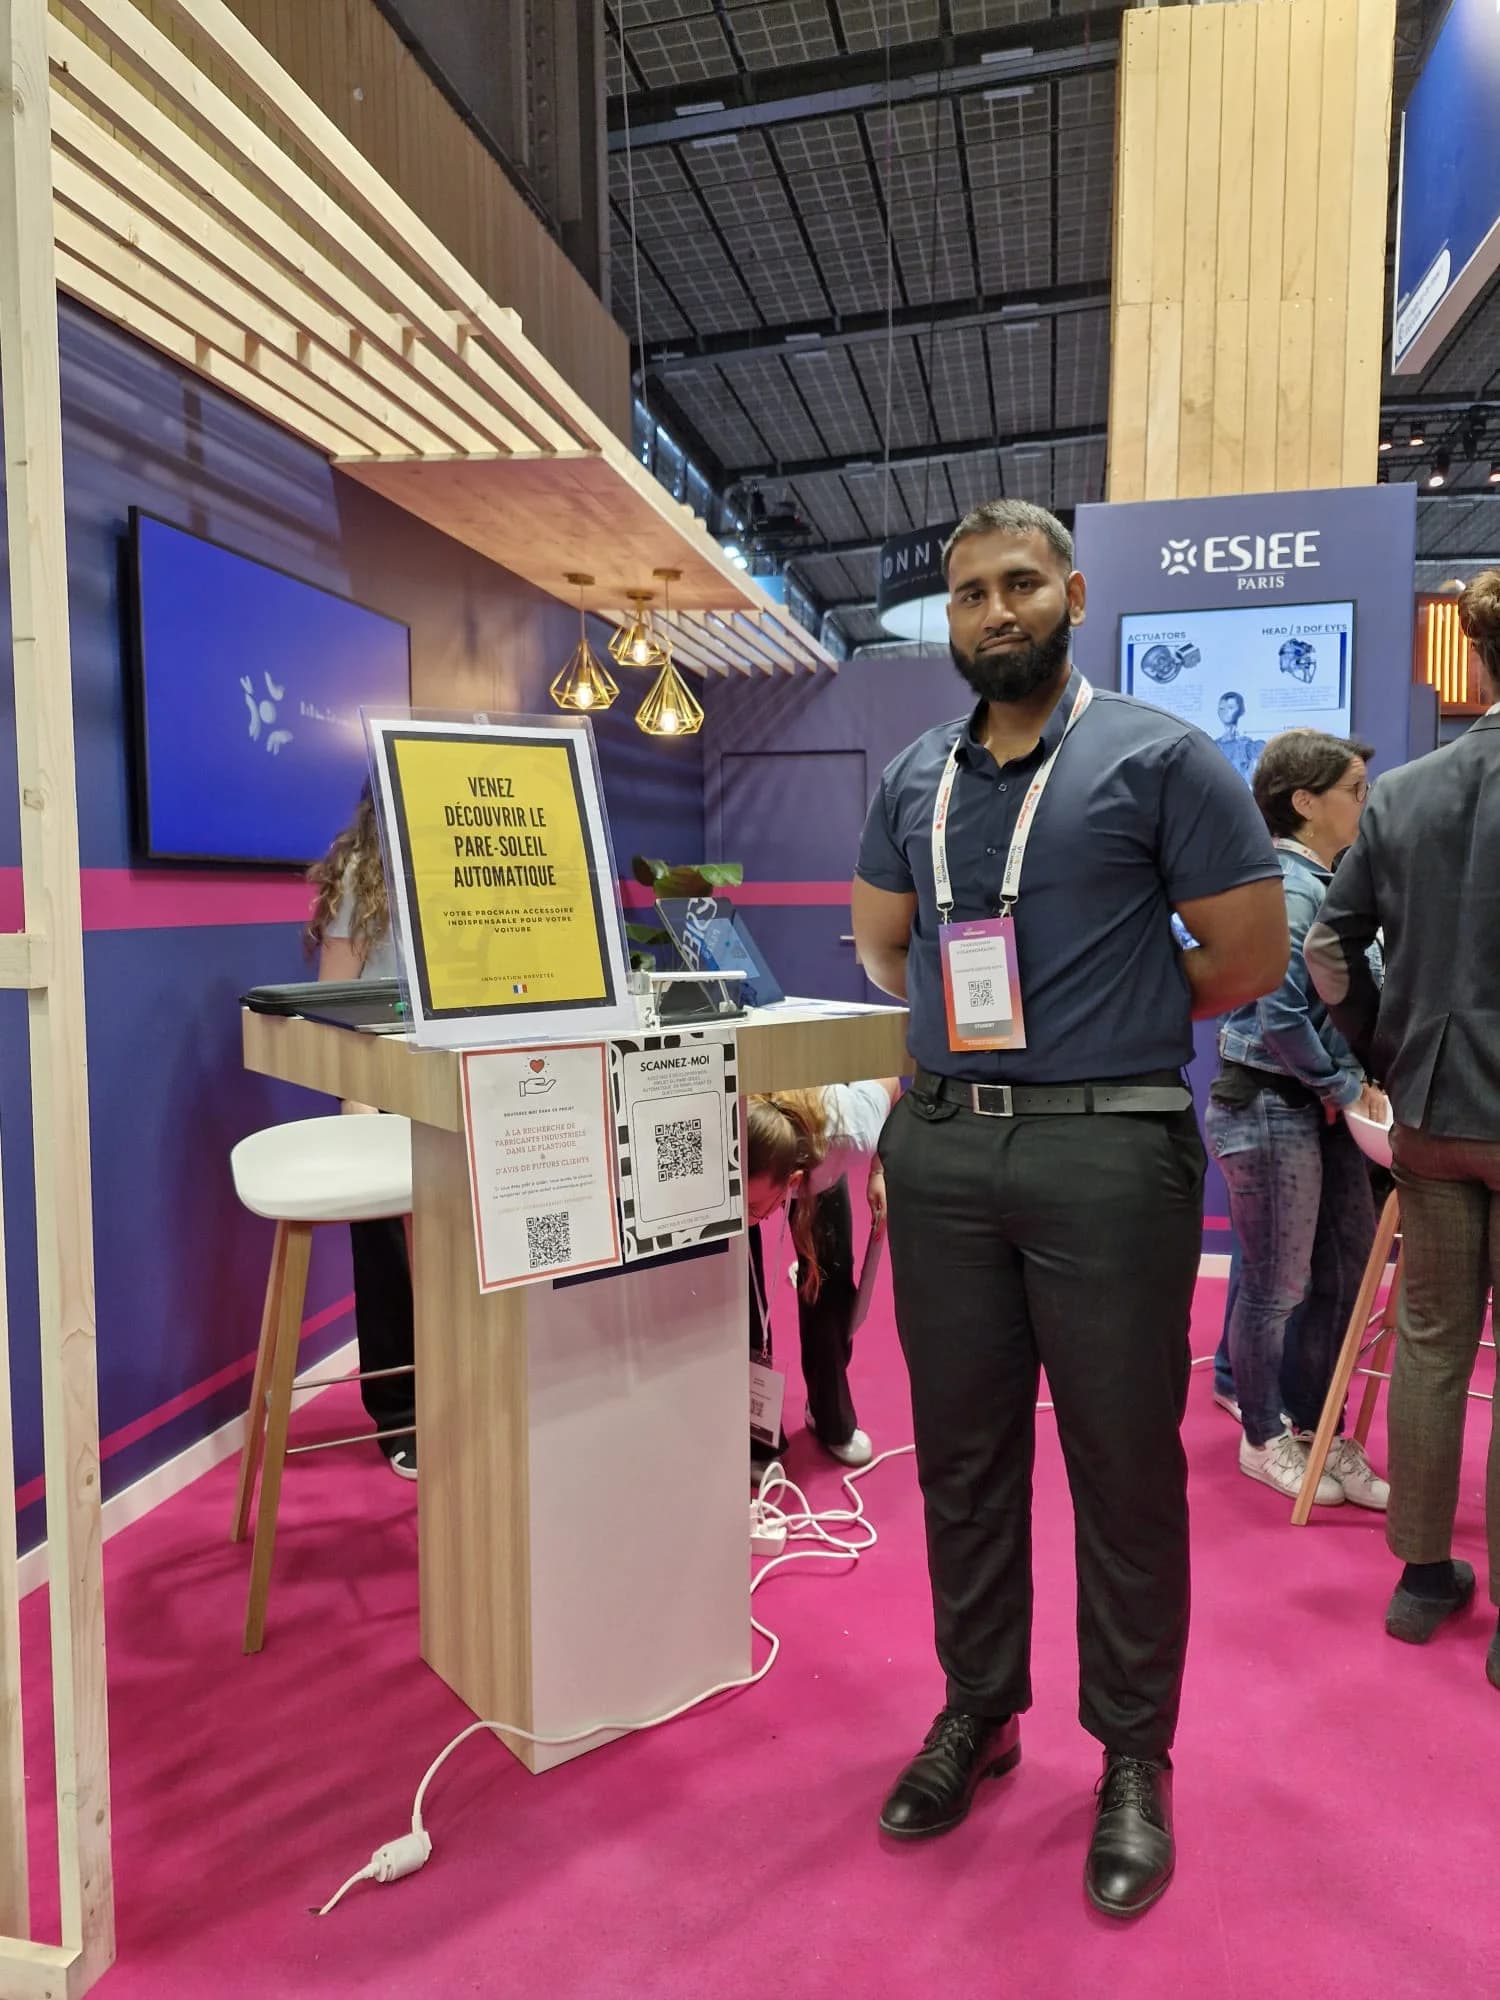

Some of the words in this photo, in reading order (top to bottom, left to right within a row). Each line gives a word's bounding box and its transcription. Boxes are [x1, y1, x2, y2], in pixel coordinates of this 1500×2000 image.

[1204, 530, 1321, 573] ESIEE
[1237, 575, 1286, 591] PARIS
[1128, 631, 1186, 641] ACTUATORS
[1262, 627, 1288, 636] HEAD
[1303, 625, 1322, 633] DOF
[1325, 623, 1347, 632] EYES
[467, 776, 515, 798] VENEZ
[444, 801, 527, 828] DÉCOUVRIR
[529, 807, 547, 828] LE
[454, 835, 548, 858] PARE-SOLEIL
[454, 865, 557, 888] AUTOMATIQUE
[475, 908, 520, 917] PROCHAIN
[523, 907, 574, 915] ACCESSOIRE
[448, 918, 517, 926] INDISPENSABLE
[494, 926, 532, 934] VOITURE
[640, 1055, 710, 1072] SCANNEZ-MOI
[523, 1124, 565, 1134] RECHERCHE
[567, 1122, 576, 1130] DE
[495, 1136, 540, 1147] FABRICANTS
[541, 1130, 587, 1142] INDUSTRIELS
[506, 1147, 526, 1155] DANS
[527, 1145, 537, 1153] LE
[538, 1141, 577, 1151] PLASTIQUE
[495, 1166, 519, 1175] D'AVIS
[521, 1164, 530, 1172] DE
[532, 1160, 560, 1170] FUTURS
[561, 1156, 590, 1166] CLIENTS
